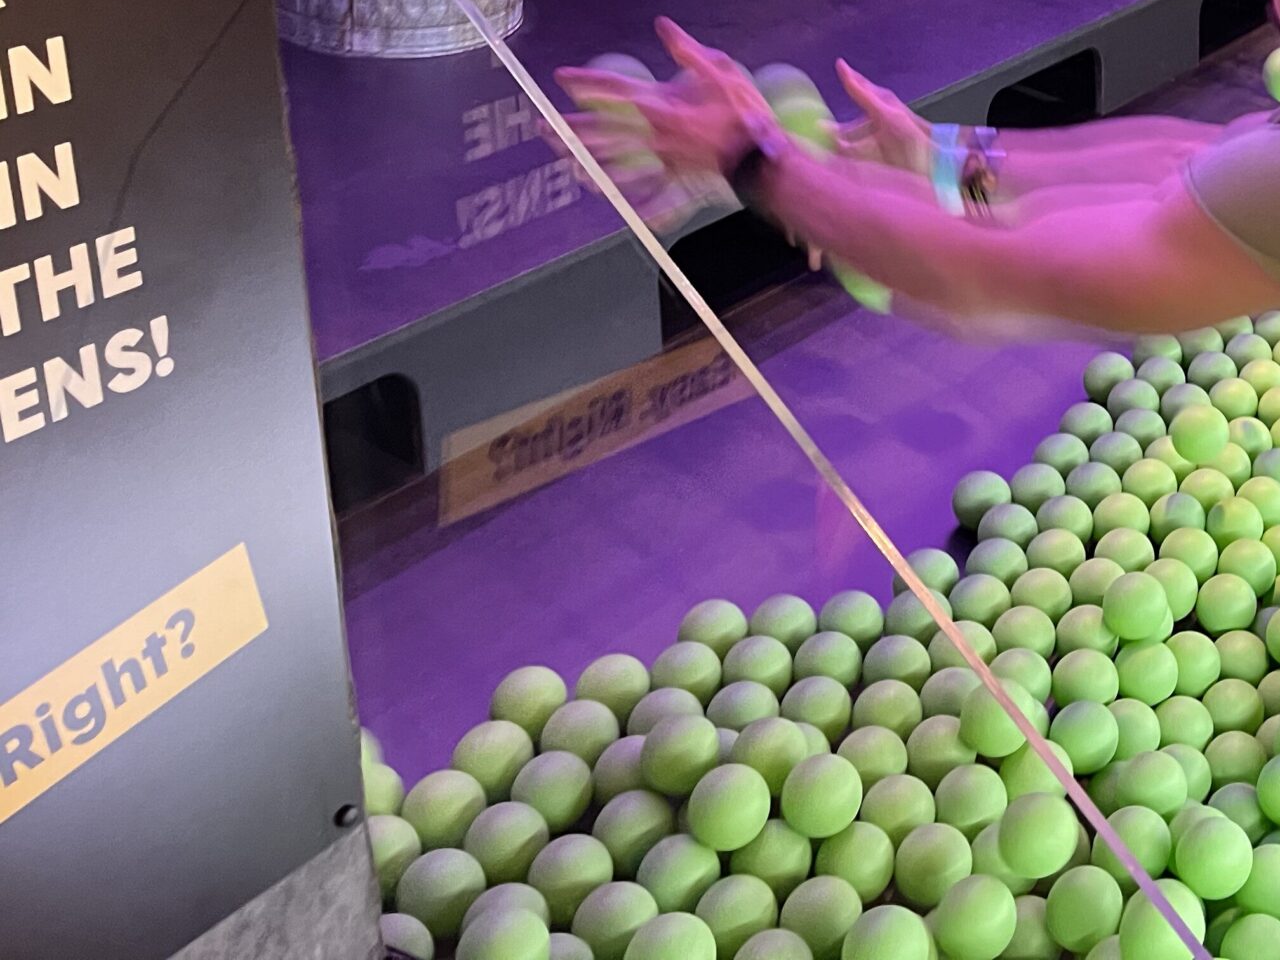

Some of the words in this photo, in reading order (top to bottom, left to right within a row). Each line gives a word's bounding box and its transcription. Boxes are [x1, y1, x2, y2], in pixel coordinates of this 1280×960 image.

[0, 226, 143, 337] THE
[0, 315, 175, 443] ENS!
[0, 608, 195, 788] Right?
